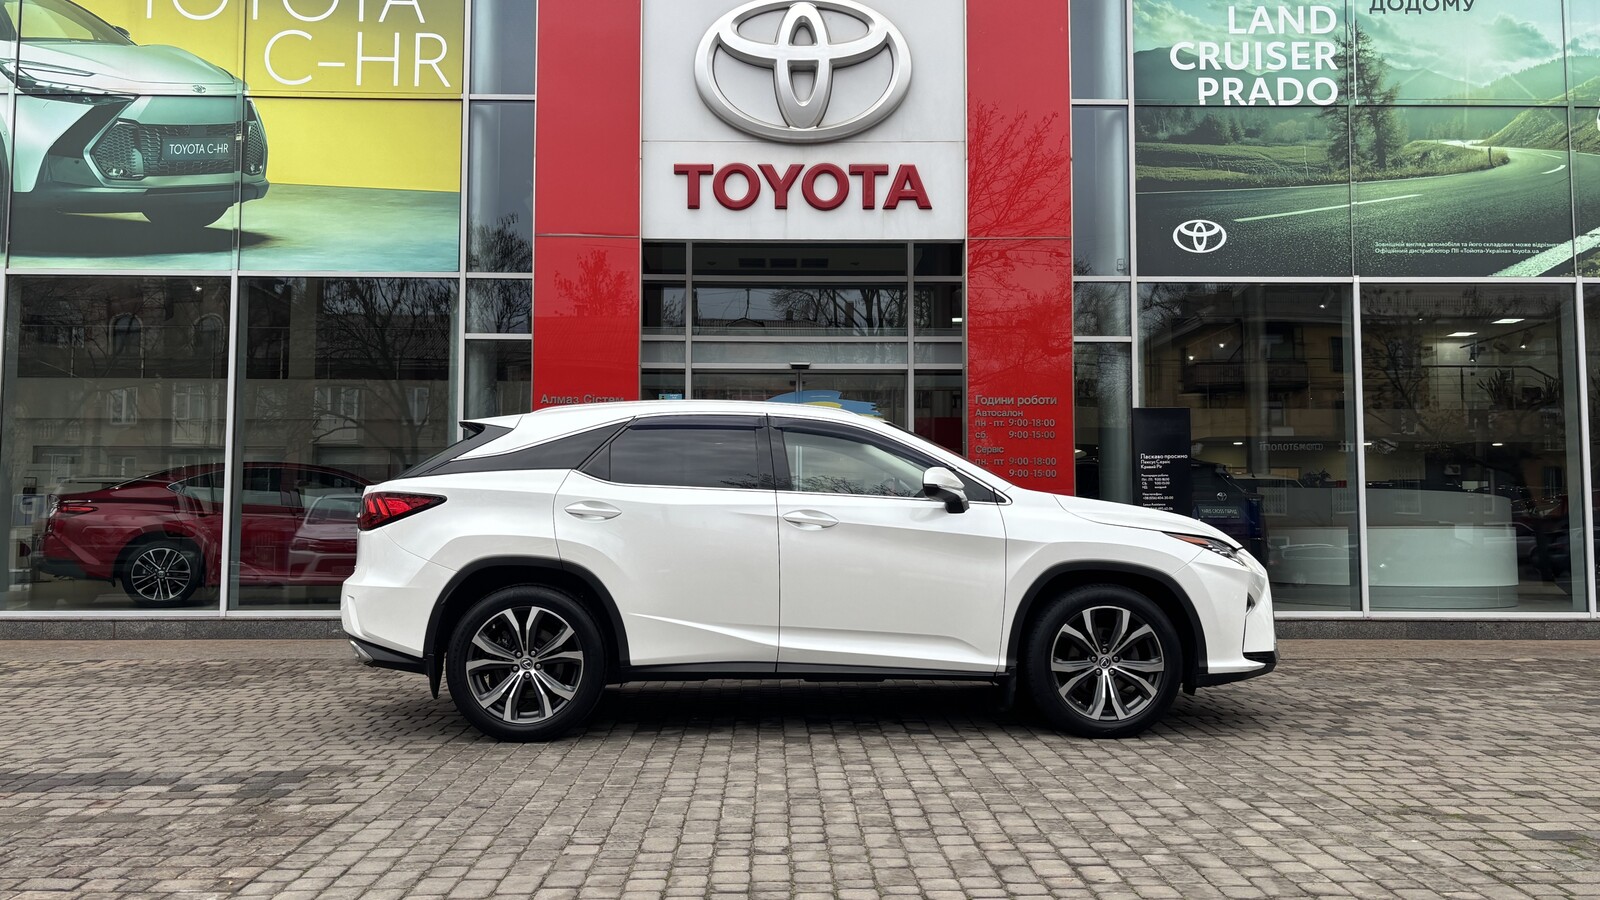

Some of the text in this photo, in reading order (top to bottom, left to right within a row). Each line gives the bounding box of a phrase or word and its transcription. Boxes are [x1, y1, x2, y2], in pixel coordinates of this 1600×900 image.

[1228, 5, 1337, 35] LAND
[265, 29, 451, 87] C-HR
[1169, 41, 1338, 71] CRUISER
[1198, 77, 1339, 106] PRADO
[169, 143, 229, 155] TOYOTA C-HR
[673, 162, 933, 211] TOYOTA
[540, 394, 579, 404] Алмаз
[975, 395, 1057, 407] Години роботи
[975, 409, 1023, 417] Автосалон
[1008, 418, 1056, 427] 9:00-18:00
[975, 430, 989, 439] сб.
[975, 445, 1004, 455] Сервіс
